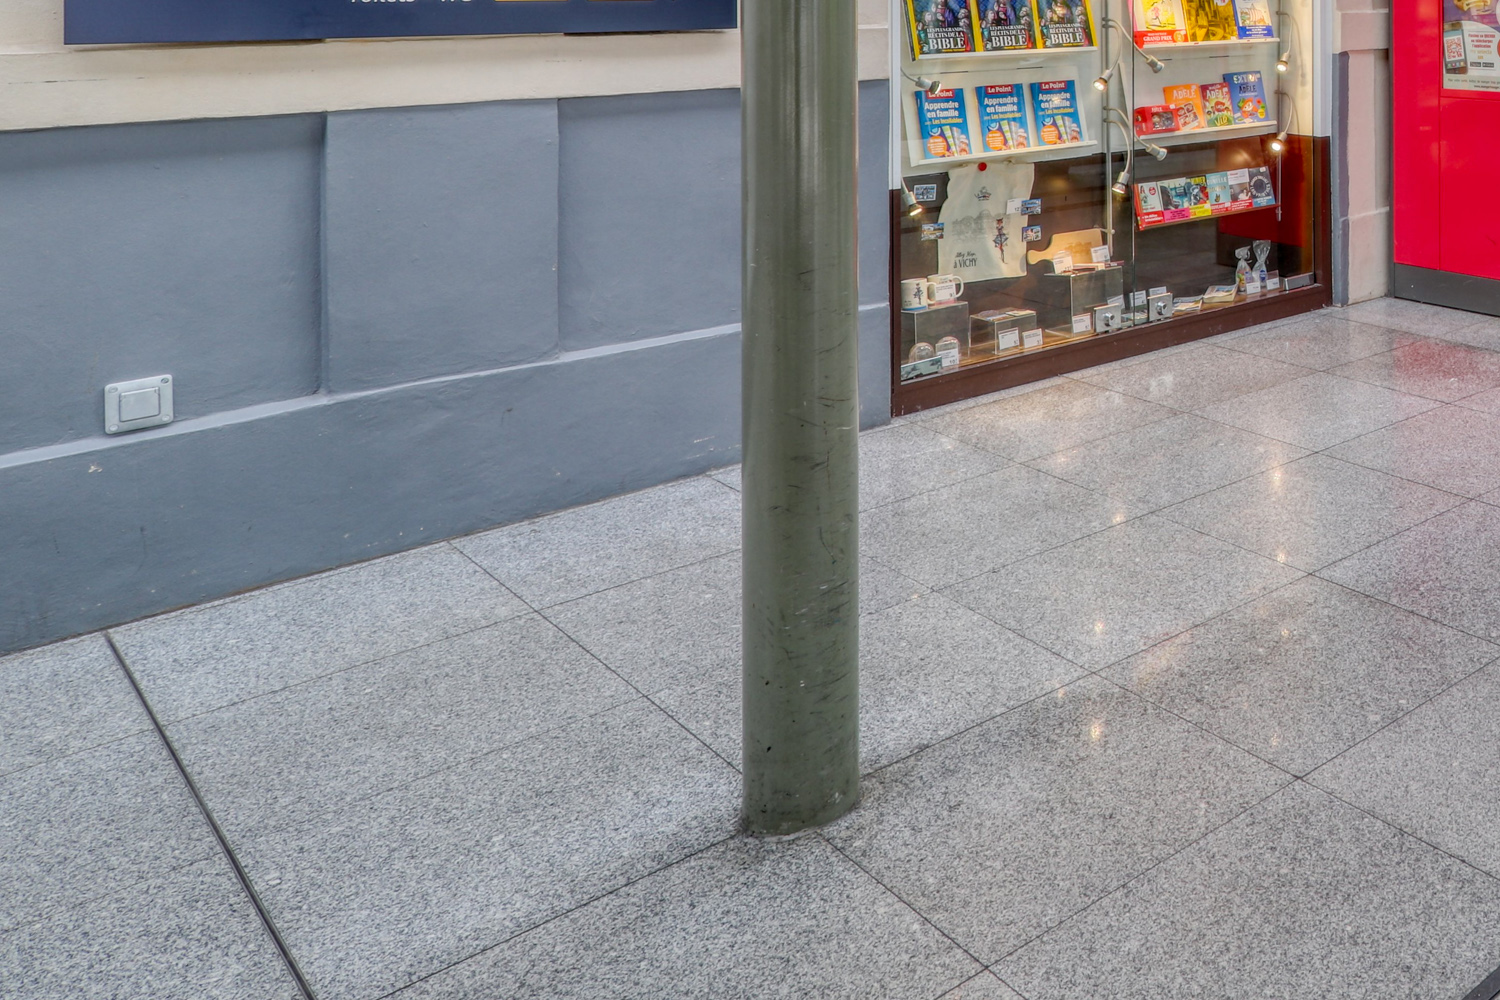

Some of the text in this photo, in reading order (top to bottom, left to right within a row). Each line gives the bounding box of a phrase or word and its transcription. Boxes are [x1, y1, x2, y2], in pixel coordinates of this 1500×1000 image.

[992, 34, 1027, 47] BIBLE
[1051, 32, 1084, 44] BIBLE
[929, 38, 965, 50] BIBLE
[984, 96, 1018, 105] Apprendre
[1038, 92, 1070, 101] Apprendre
[924, 101, 959, 110] Apprendre
[996, 104, 1018, 112] famille
[937, 109, 959, 117] famille
[959, 257, 978, 268] VICHY
